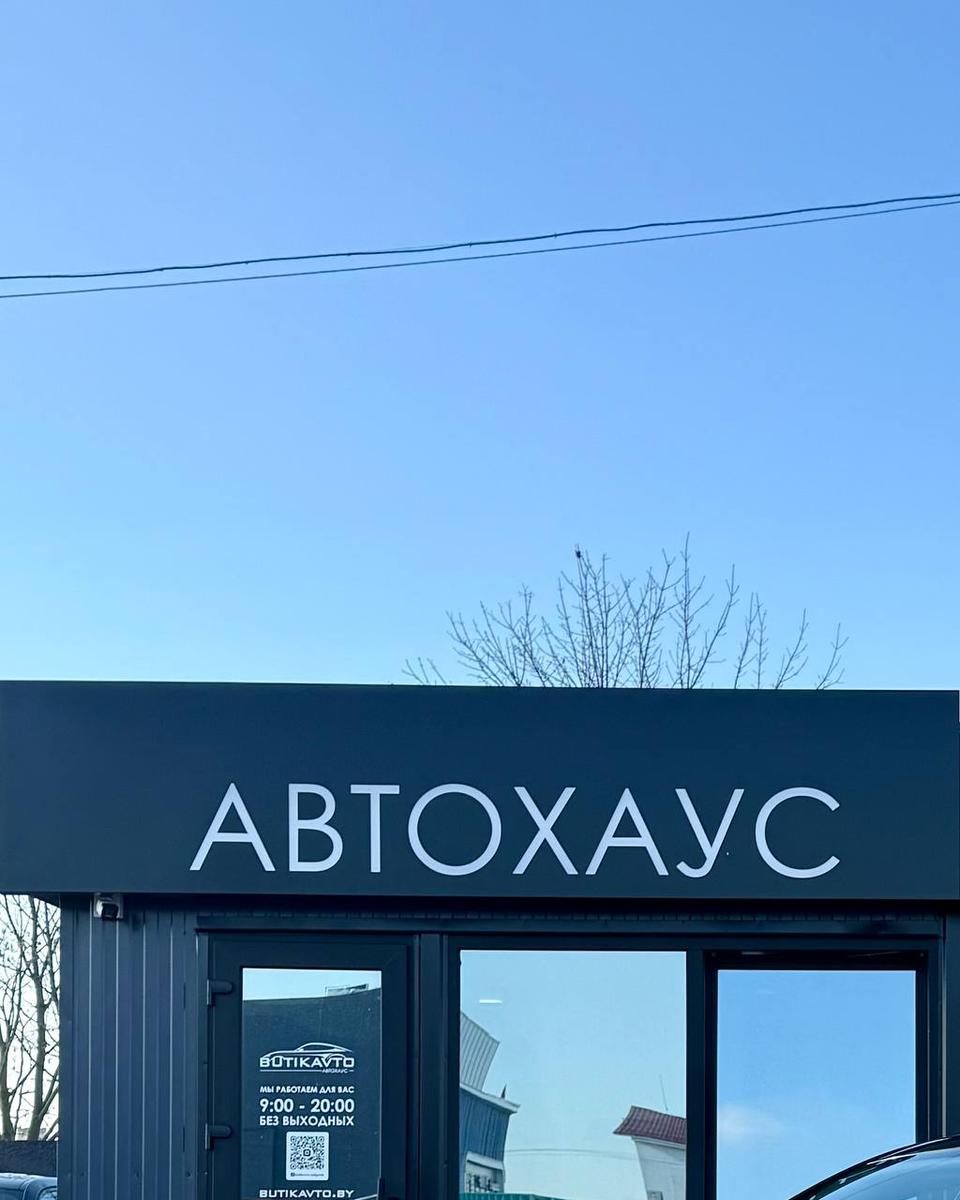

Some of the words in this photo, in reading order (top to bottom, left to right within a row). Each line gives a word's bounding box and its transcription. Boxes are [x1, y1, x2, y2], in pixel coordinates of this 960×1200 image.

[190, 782, 841, 879] АВТОХАУС
[259, 1056, 355, 1068] BUTIKAVTO
[259, 1086, 274, 1094] МЫ
[276, 1086, 318, 1094] РАБОТАЕМ
[319, 1086, 336, 1094] ДЛЯ
[337, 1086, 355, 1094] ВАС
[259, 1098, 294, 1113] 9:00
[310, 1098, 355, 1113] 20:00
[259, 1115, 279, 1126] БЕЗ
[282, 1115, 354, 1127] ВЫХОДНЫХ
[259, 1189, 355, 1198] BUTIKAVTO.BY
